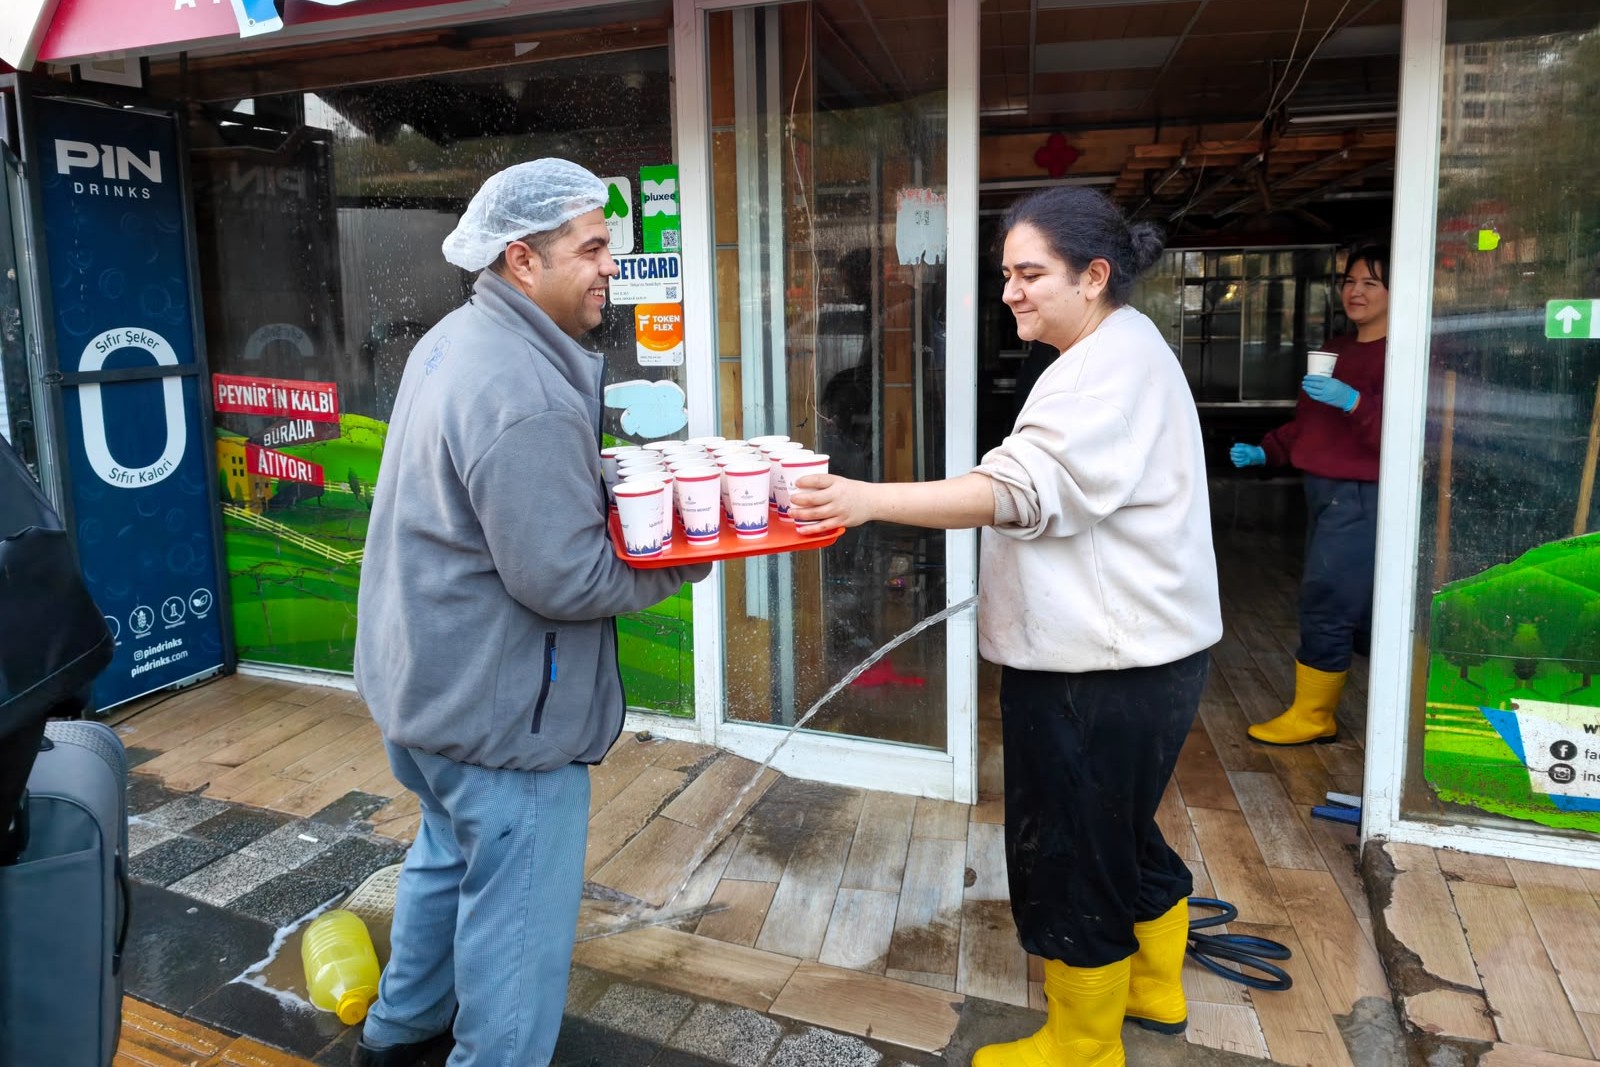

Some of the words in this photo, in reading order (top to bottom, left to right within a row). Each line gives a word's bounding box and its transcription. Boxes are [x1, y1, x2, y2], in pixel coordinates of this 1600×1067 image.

[74, 182, 151, 199] DRINKS
[644, 192, 676, 203] pluxee
[652, 315, 680, 323] TOKEN
[653, 323, 674, 331] FLEX
[125, 330, 160, 349] Şeker
[291, 387, 335, 414] KALBİ
[263, 418, 315, 446] BURADA
[138, 458, 173, 483] Kalori
[258, 448, 312, 482] ATIYOR!
[131, 650, 188, 678] pindrinks.com
